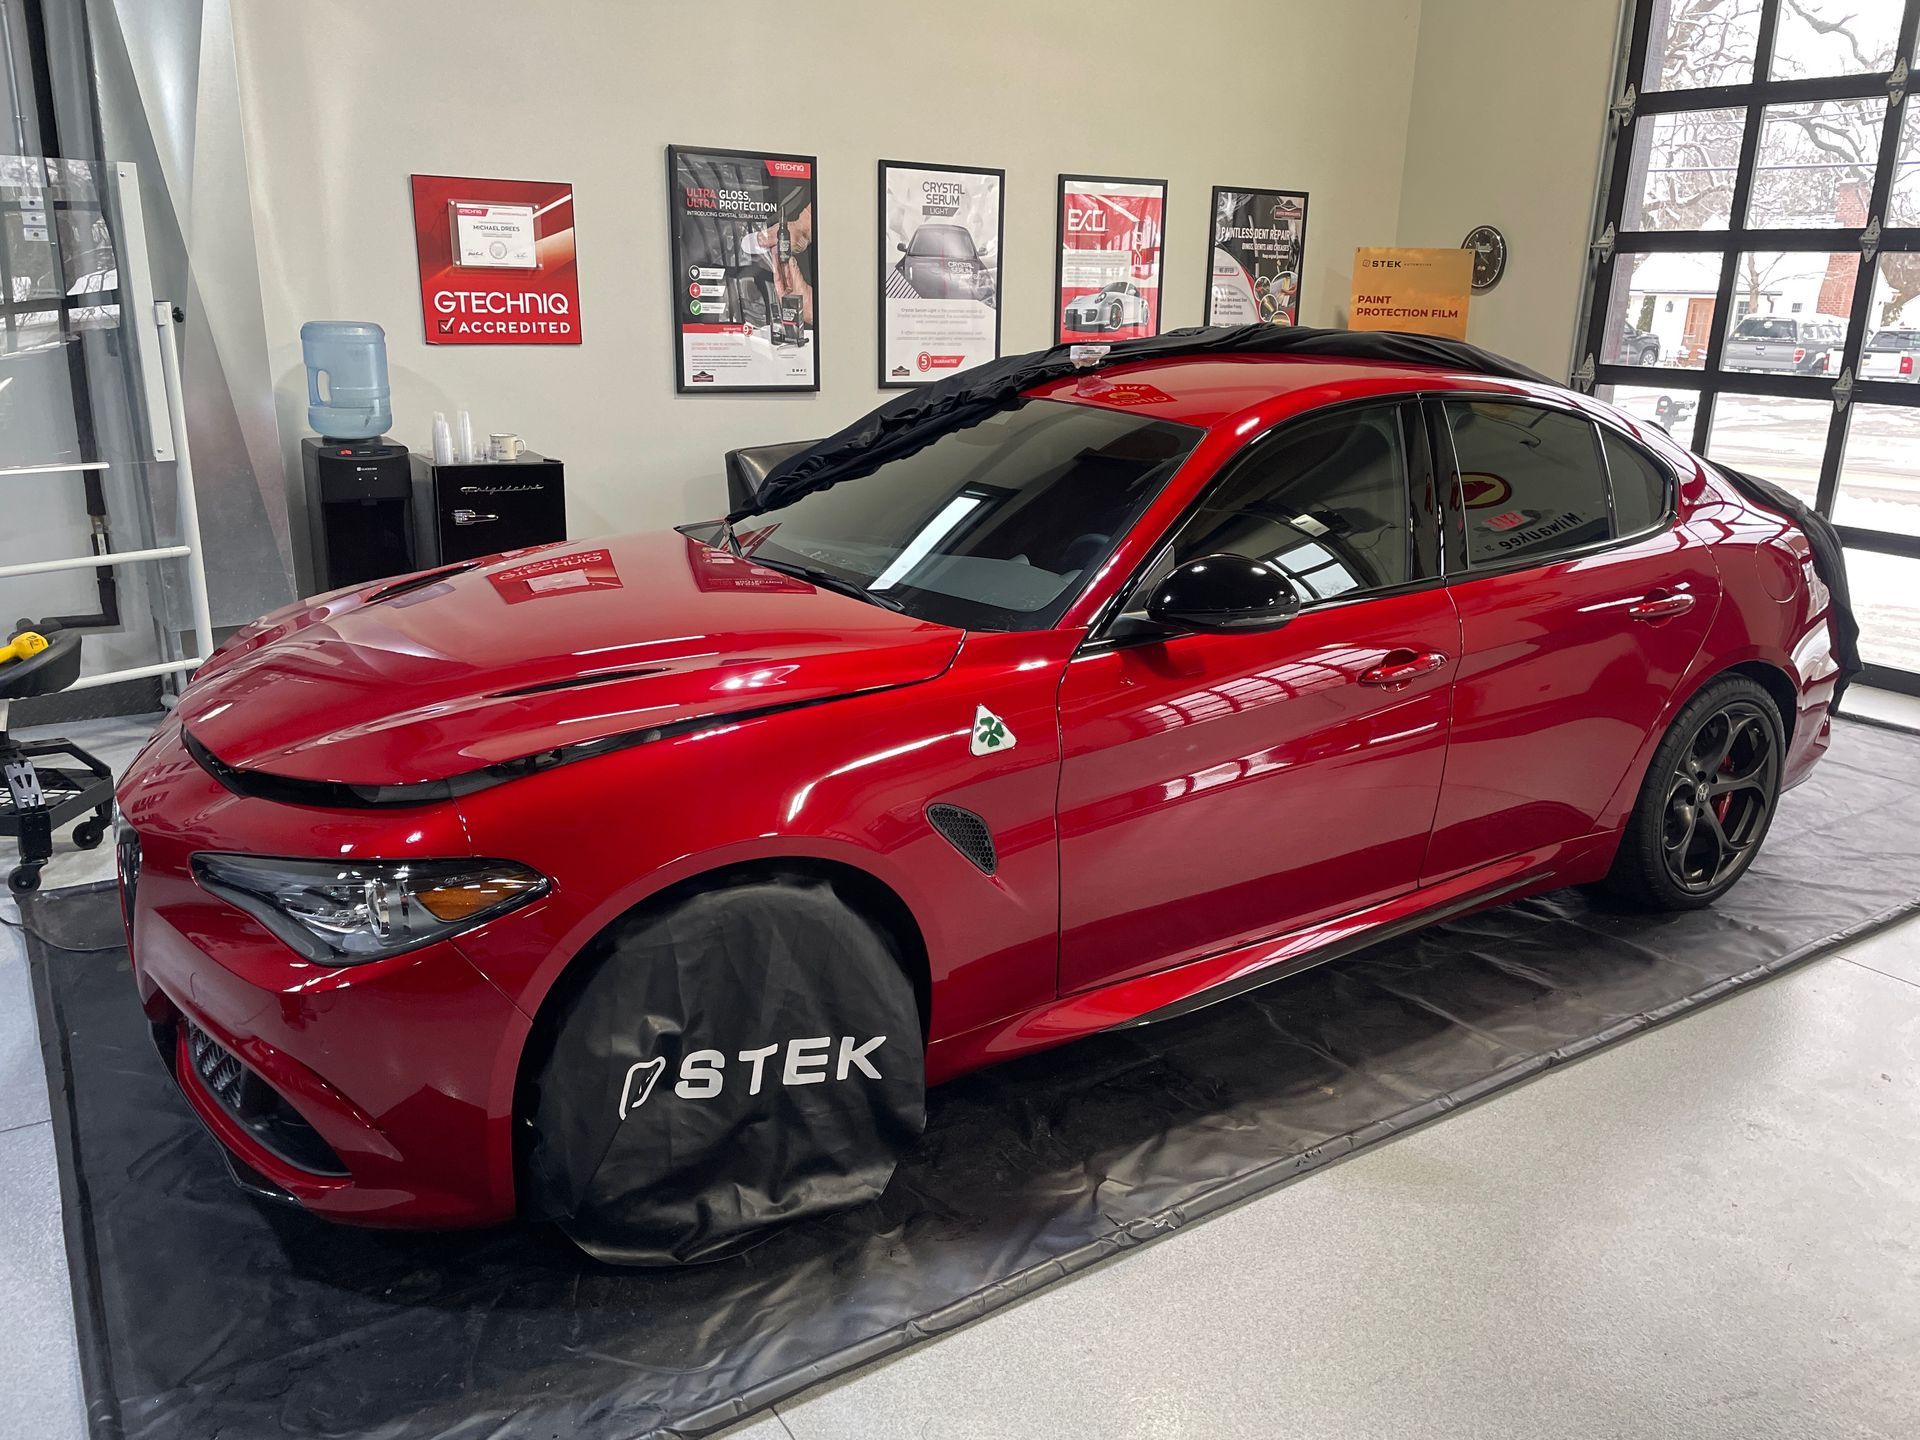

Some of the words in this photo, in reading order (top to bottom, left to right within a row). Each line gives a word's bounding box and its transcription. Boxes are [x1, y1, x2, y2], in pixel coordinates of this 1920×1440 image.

[774, 163, 805, 172] GTECHNIQ
[686, 187, 717, 199] ULTRA
[719, 189, 751, 201] GLOSS,
[922, 181, 966, 195] CRYSTAL
[686, 198, 717, 208] ULTRA
[719, 200, 777, 212] PROTECTION
[925, 194, 960, 206] SERUM
[929, 207, 949, 215] LIGHT
[1254, 228, 1269, 240] DENT
[1270, 229, 1290, 240] REPAIR
[1372, 260, 1402, 268] STEK
[433, 290, 569, 315] GTECHNIQ
[1357, 295, 1392, 304] PAINT
[1356, 307, 1428, 318] PROTECTION
[1431, 309, 1459, 318] FILM
[458, 321, 571, 334] ACCREDITED
[921, 356, 928, 366] 5
[674, 1036, 887, 1099] STEK
